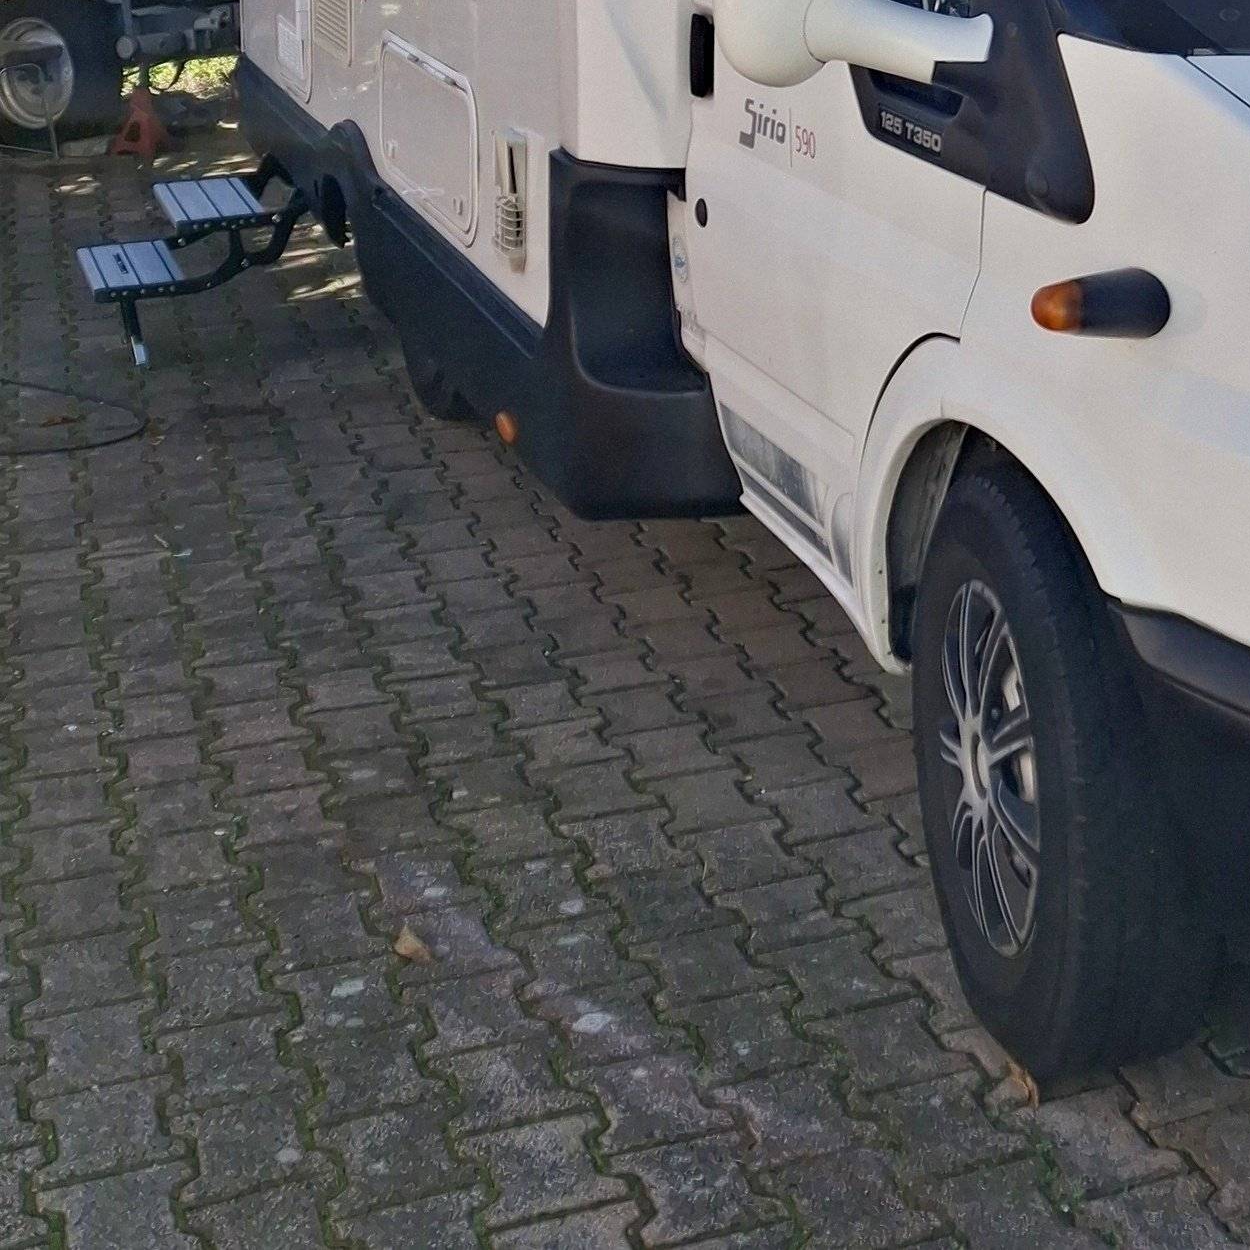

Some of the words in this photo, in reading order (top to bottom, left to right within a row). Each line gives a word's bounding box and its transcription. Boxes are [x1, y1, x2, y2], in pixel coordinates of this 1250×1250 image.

[739, 98, 786, 149] Sirio
[795, 125, 816, 159] 590
[881, 111, 903, 135] 125
[905, 121, 942, 152] T350
